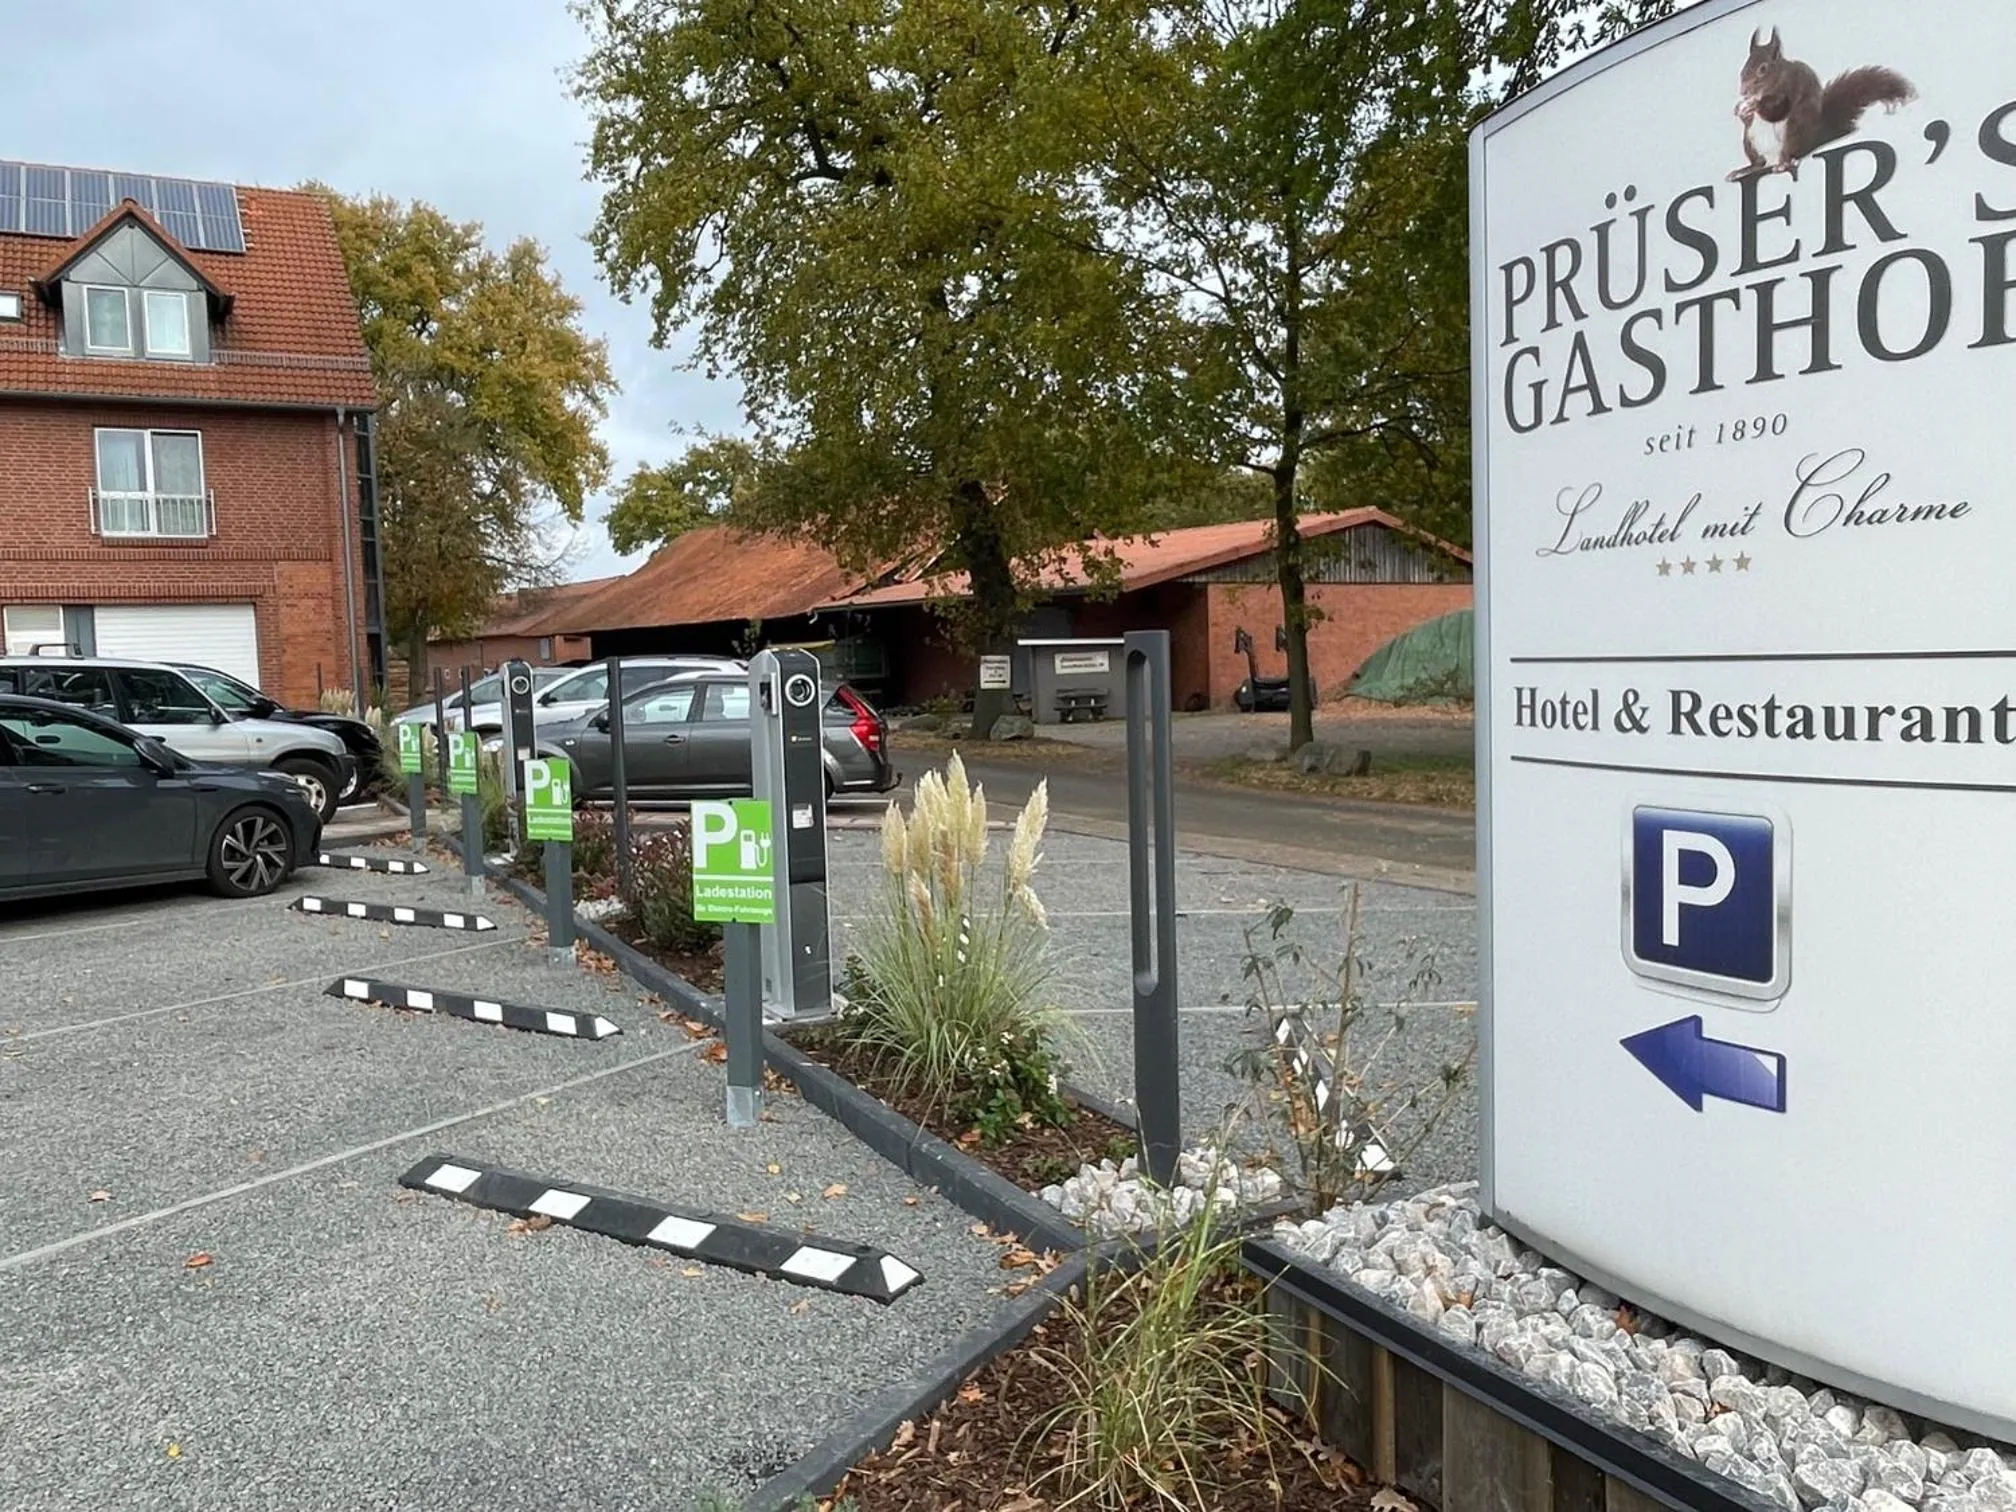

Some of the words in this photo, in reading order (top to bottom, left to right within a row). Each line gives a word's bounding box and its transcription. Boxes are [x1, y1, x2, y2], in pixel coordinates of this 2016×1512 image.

[1643, 424, 1697, 456] seit
[1714, 412, 1789, 446] 1890
[1535, 481, 1702, 558] Landhotel
[1701, 501, 1763, 542] mit
[1783, 448, 1973, 539] Charme
[1513, 686, 1601, 734] Hotel
[1613, 687, 1651, 736] &
[1665, 688, 2016, 747] Restaurant
[448, 733, 465, 769] P
[524, 759, 551, 805] P
[693, 802, 738, 869] P
[695, 884, 773, 900] Ladestation
[1661, 829, 1736, 947] P
